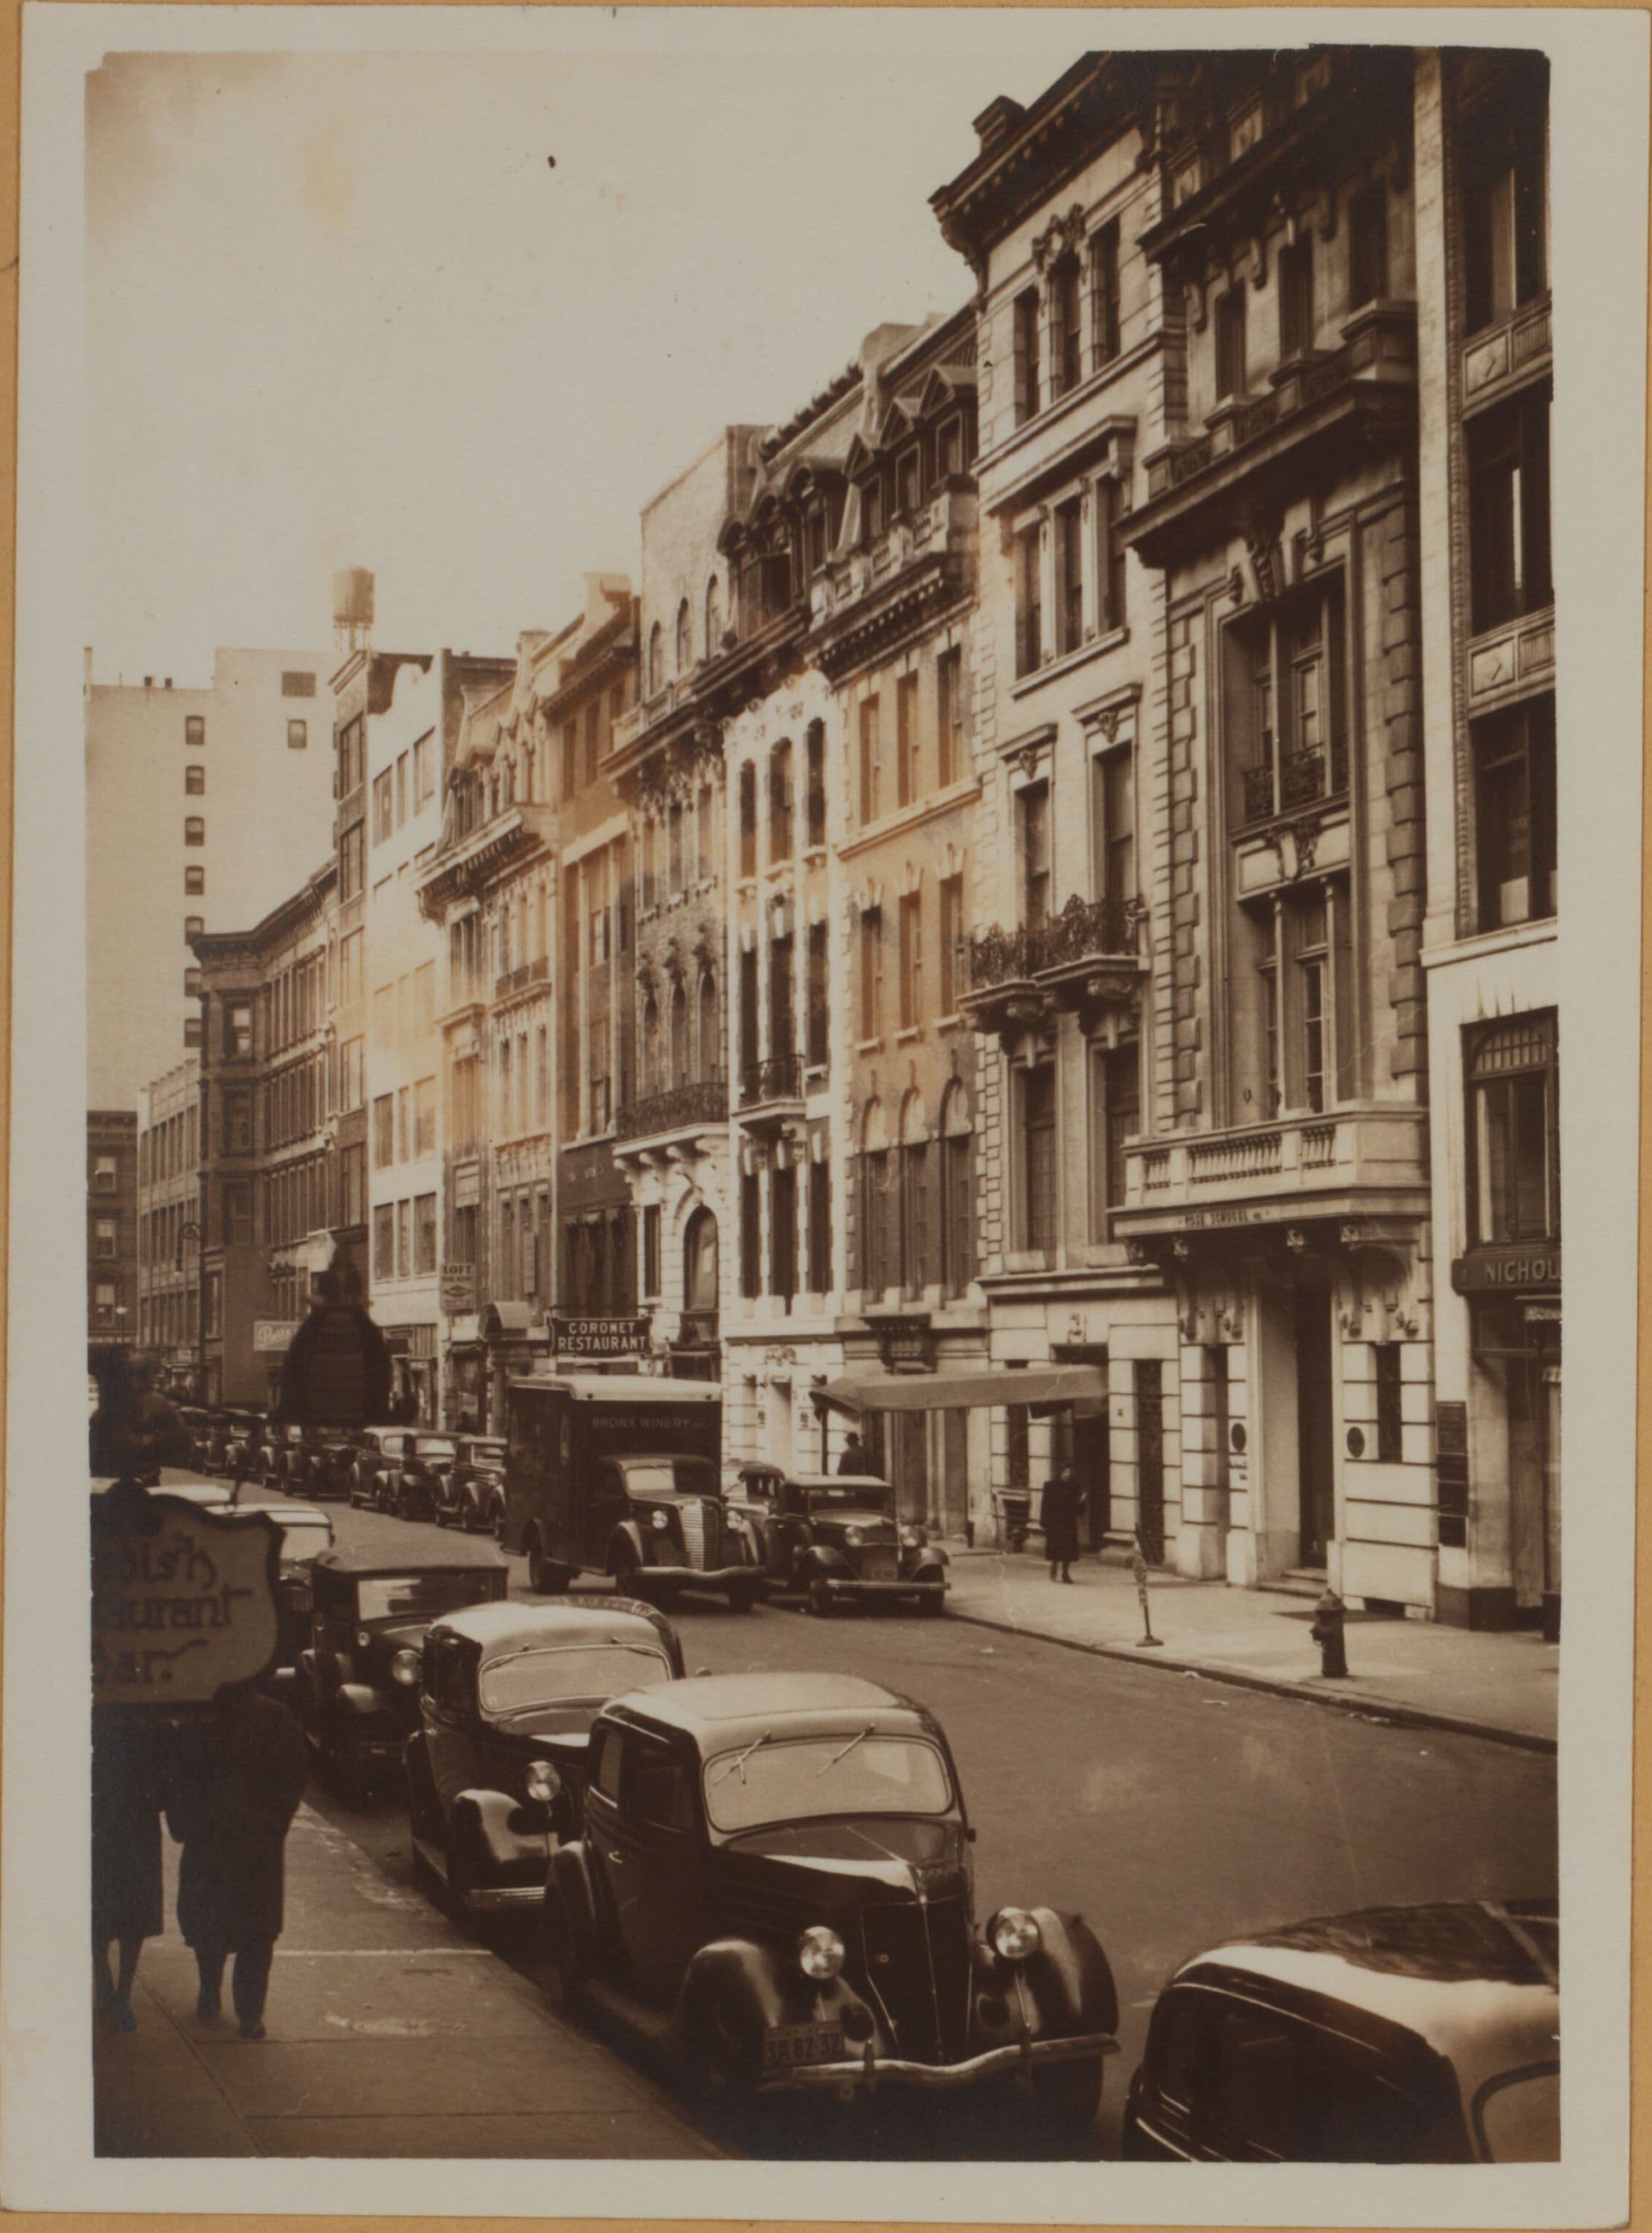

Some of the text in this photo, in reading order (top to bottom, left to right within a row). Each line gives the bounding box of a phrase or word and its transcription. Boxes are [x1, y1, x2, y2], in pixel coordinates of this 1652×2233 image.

[444, 1265, 471, 1275] LOFT
[1484, 1258, 1561, 1282] NICHOL
[569, 1321, 636, 1335] CORONET
[557, 1336, 647, 1351] RESTAURANT
[592, 1416, 636, 1429] BRONX
[640, 1416, 691, 1429] WINERY
